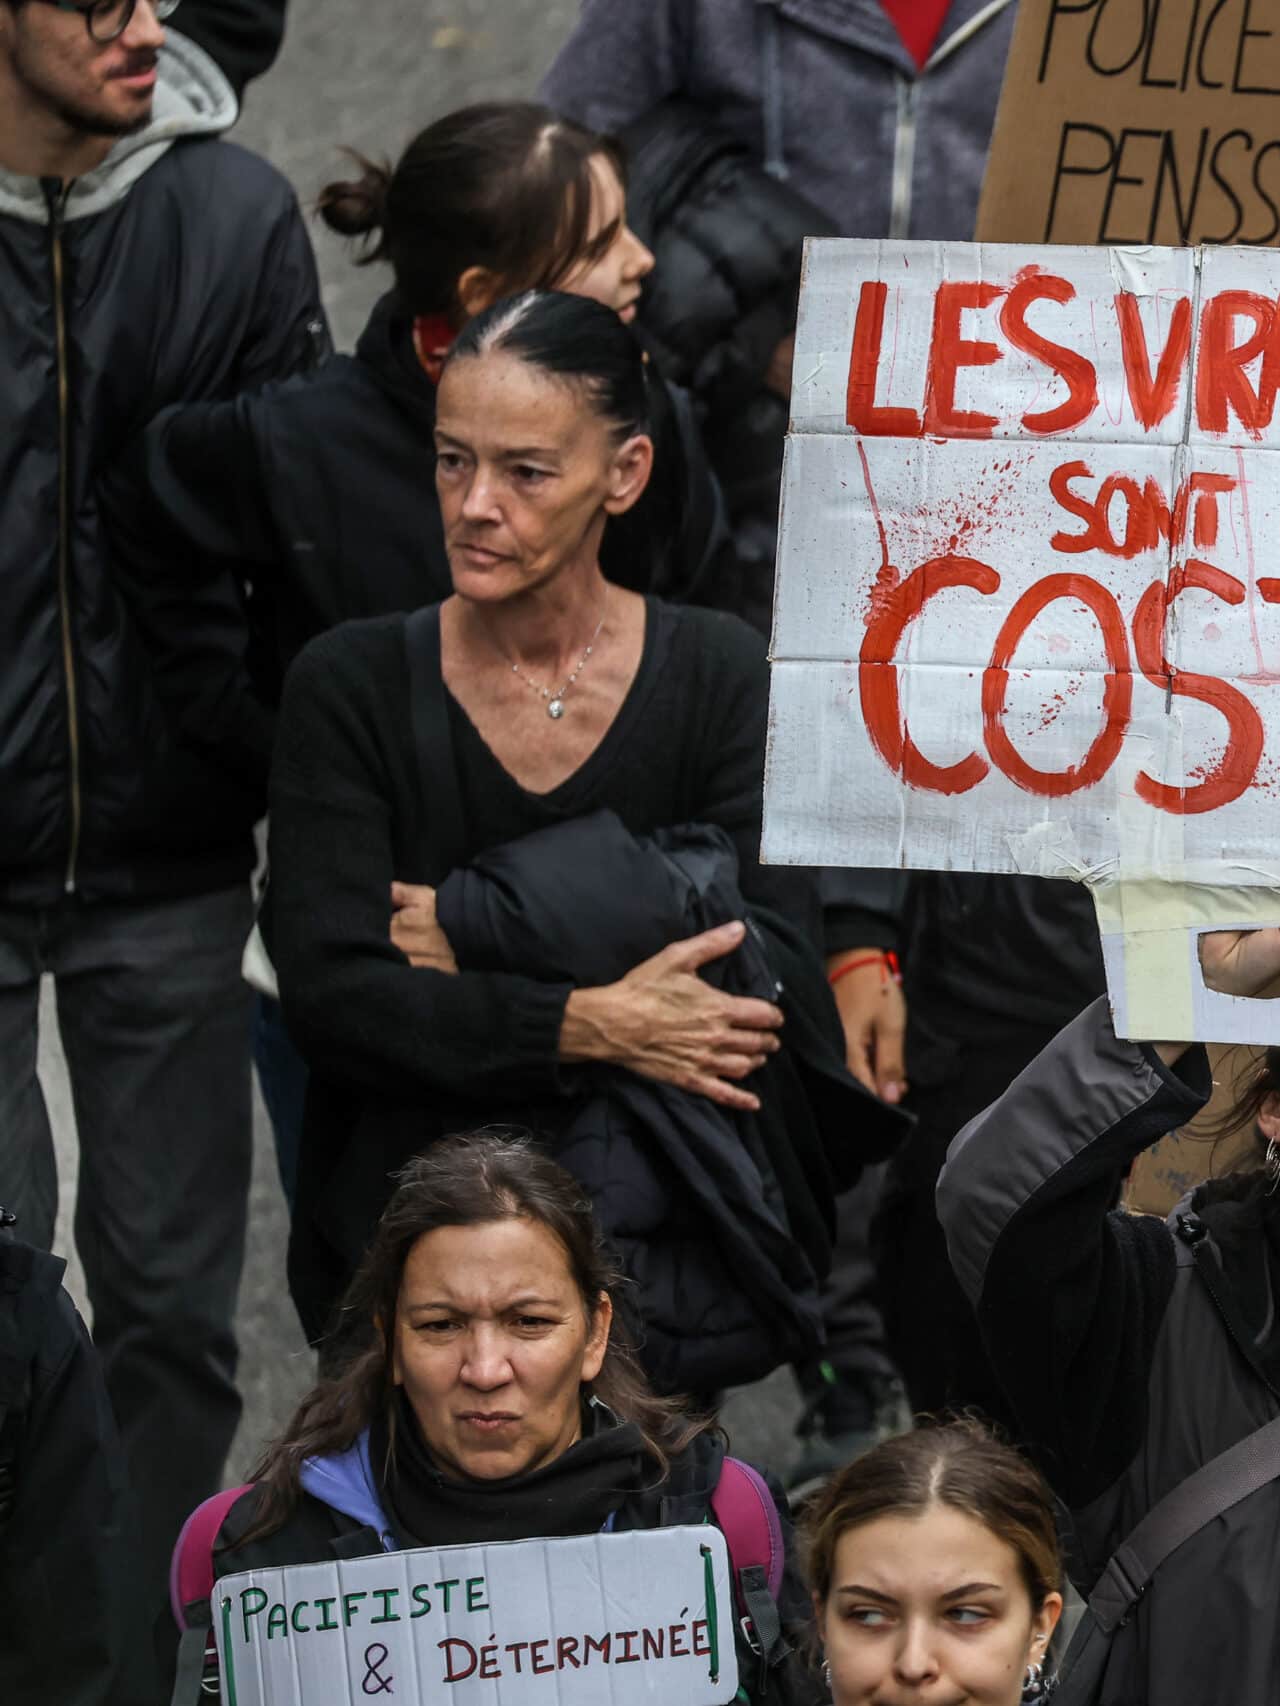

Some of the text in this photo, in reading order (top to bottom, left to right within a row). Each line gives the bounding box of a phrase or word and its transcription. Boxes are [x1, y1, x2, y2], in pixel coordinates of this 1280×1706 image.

[846, 274, 1098, 439] LES
[1048, 459, 1238, 557] SONT
[241, 1576, 490, 1643] PACIFISTE
[361, 1606, 712, 1695] & DÉTERMINÉE
